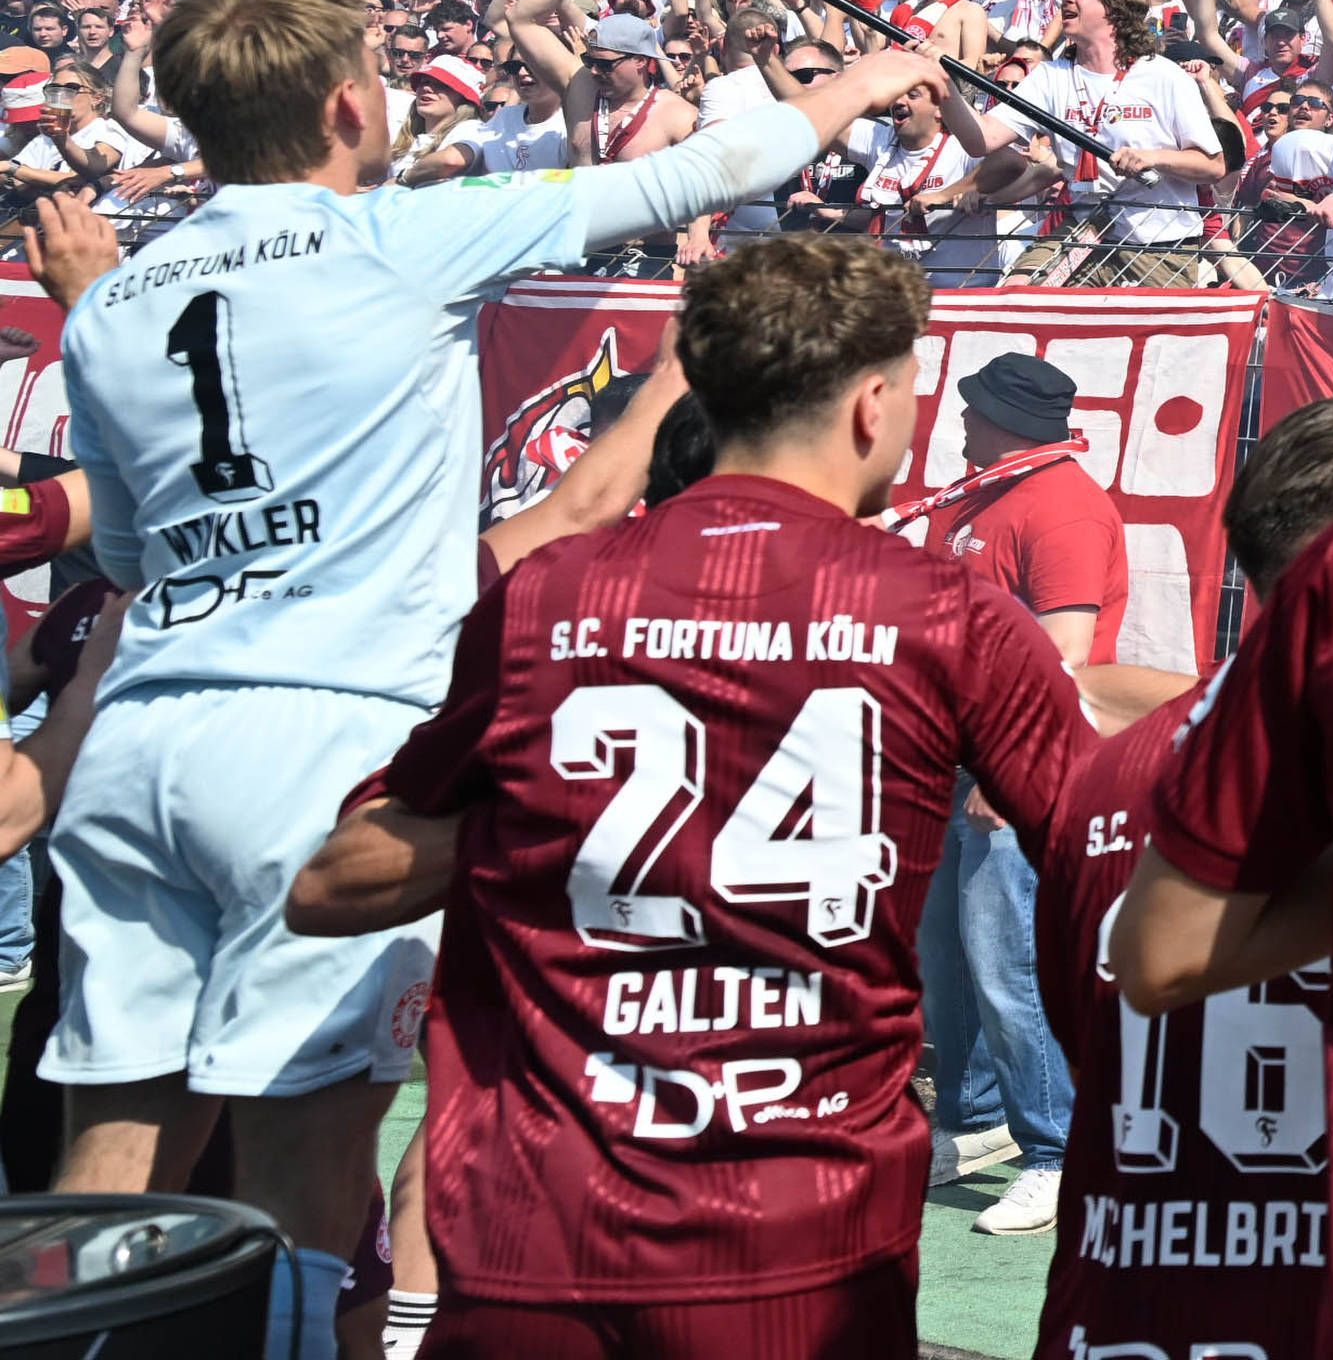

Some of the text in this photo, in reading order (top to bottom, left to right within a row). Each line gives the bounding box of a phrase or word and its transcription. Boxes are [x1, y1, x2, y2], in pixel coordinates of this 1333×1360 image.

[1122, 106, 1153, 119] SUB
[141, 244, 245, 294] FORTUNA
[254, 229, 325, 264] KÖLN
[166, 290, 275, 503] 1
[160, 498, 321, 566] WKLER
[283, 585, 314, 600] AG
[550, 614, 899, 666] S.C. FORTUNA KÖLN
[550, 683, 898, 952] 24
[1086, 810, 1134, 857] S.C.
[602, 965, 823, 1037] GALJEN
[753, 1091, 850, 1126] office AG
[1079, 1193, 1329, 1269] MCHELBRI
